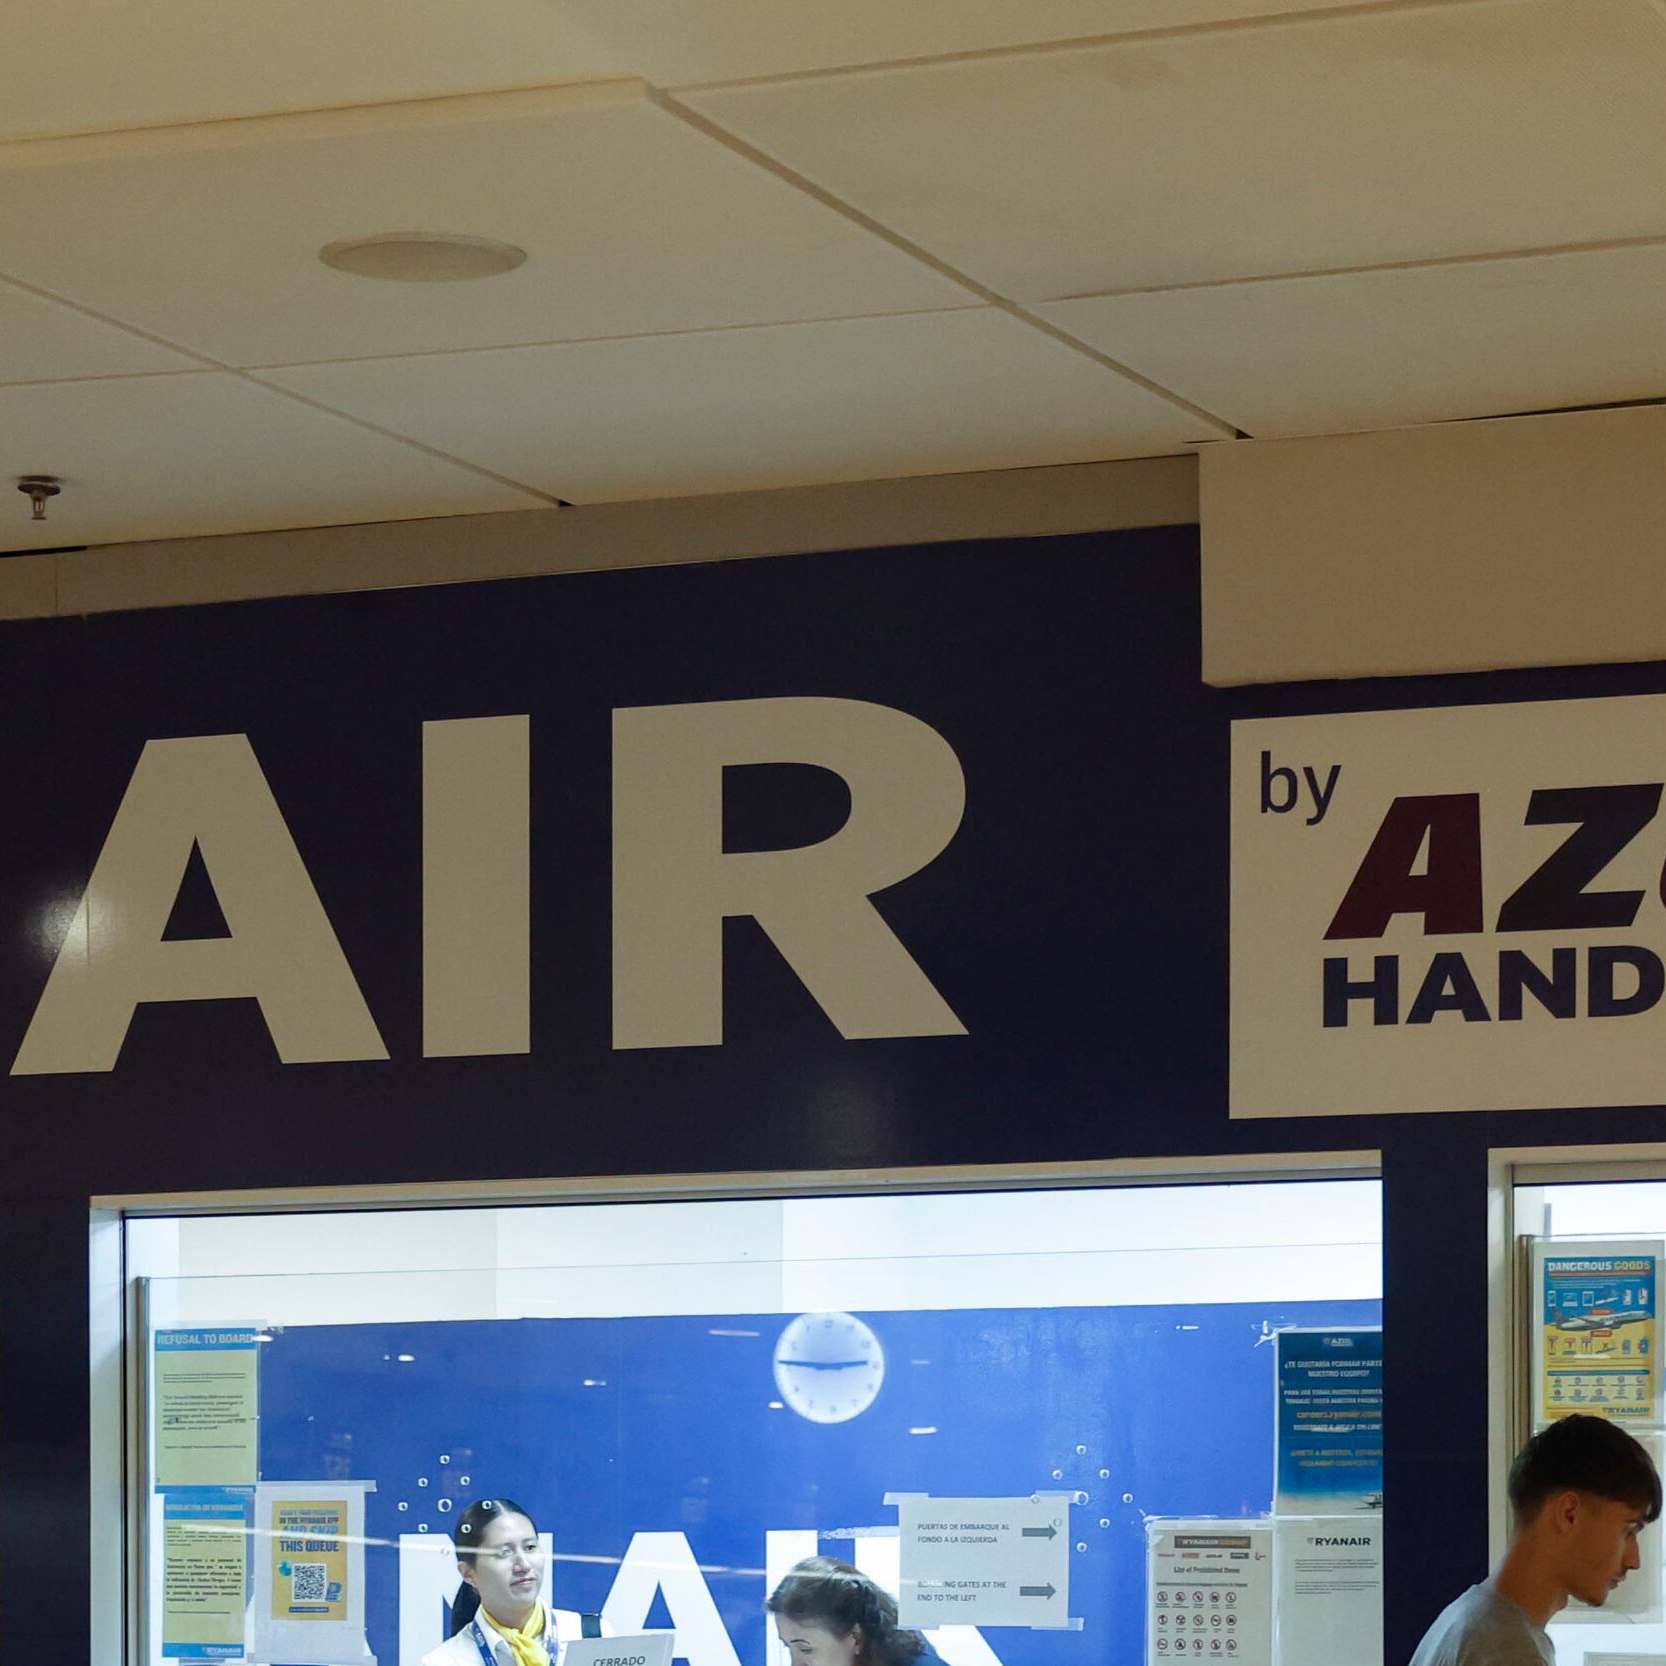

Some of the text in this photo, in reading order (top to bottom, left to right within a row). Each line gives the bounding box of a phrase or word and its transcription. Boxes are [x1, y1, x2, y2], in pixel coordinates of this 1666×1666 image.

[1260, 750, 1341, 825] by
[1548, 1261, 1612, 1271] DANGEROUS
[157, 1334, 254, 1344] REFUSAL TO BOARD
[280, 1540, 339, 1552] THIS QUEUE
[1315, 1537, 1371, 1546] RYANAIR
